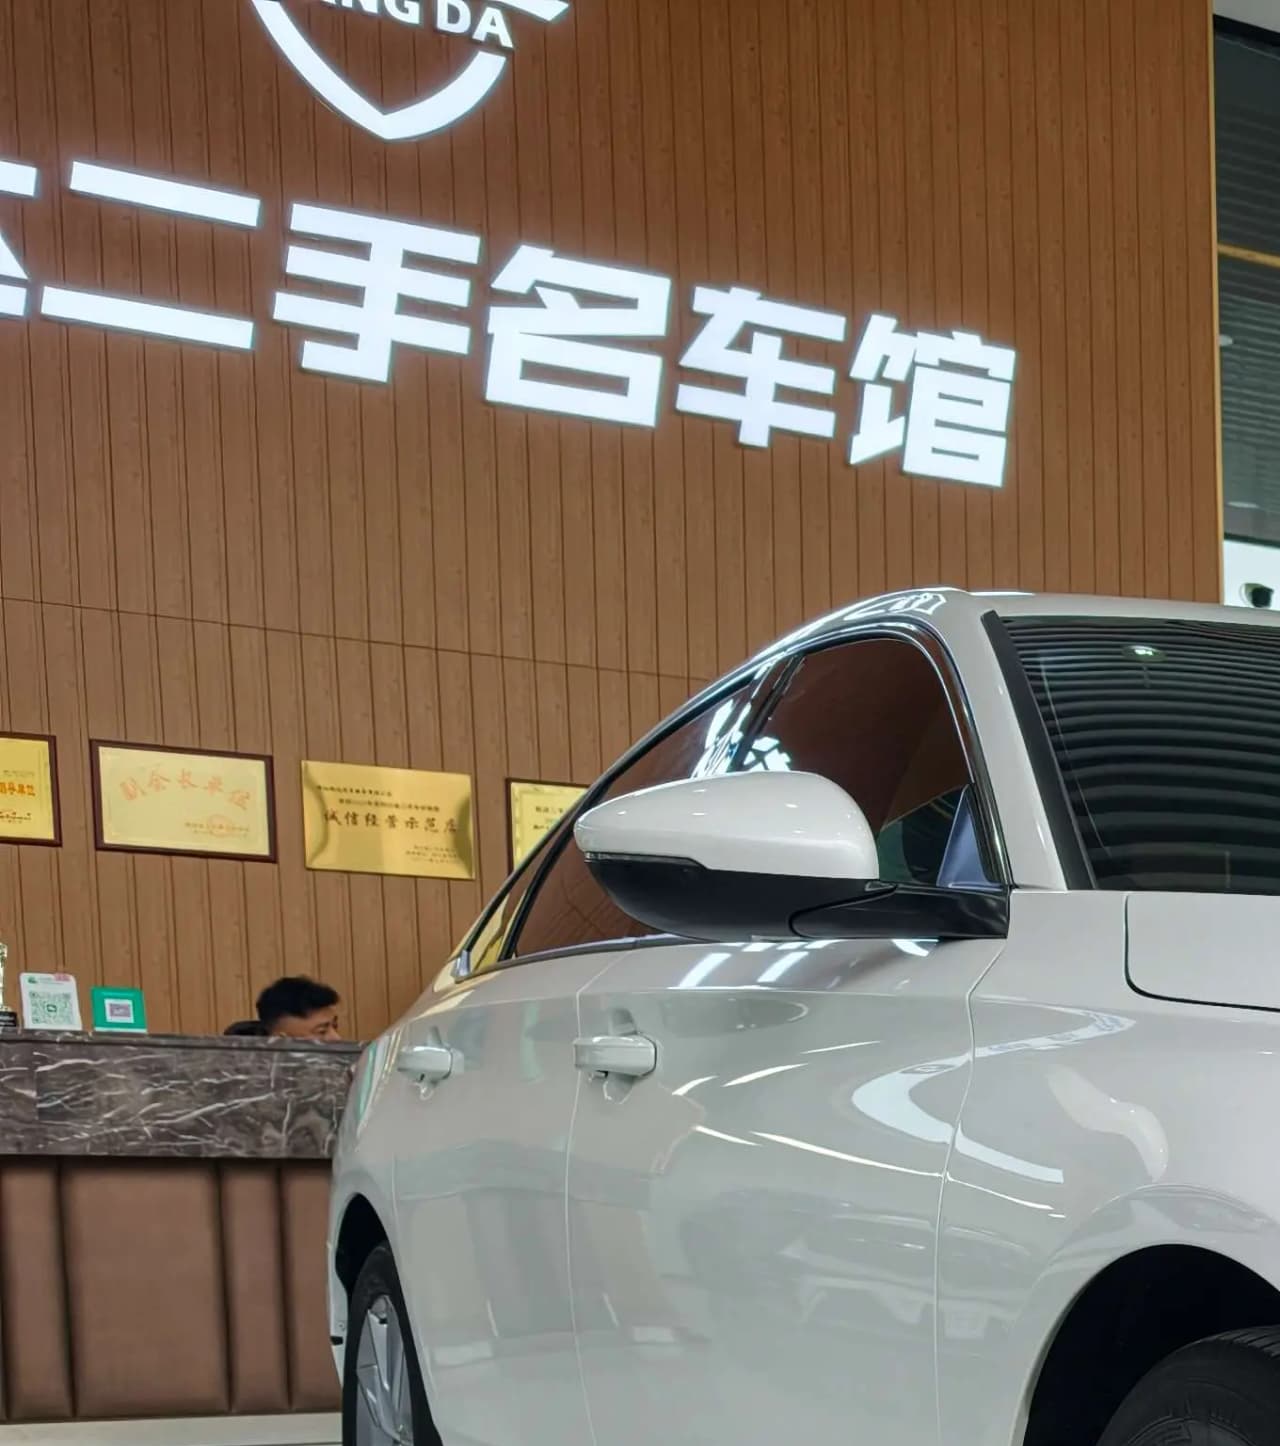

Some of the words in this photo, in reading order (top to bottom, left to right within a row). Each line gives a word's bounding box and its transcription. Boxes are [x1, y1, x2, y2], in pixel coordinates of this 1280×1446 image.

[0, 160, 1016, 487] 二手名车馆
